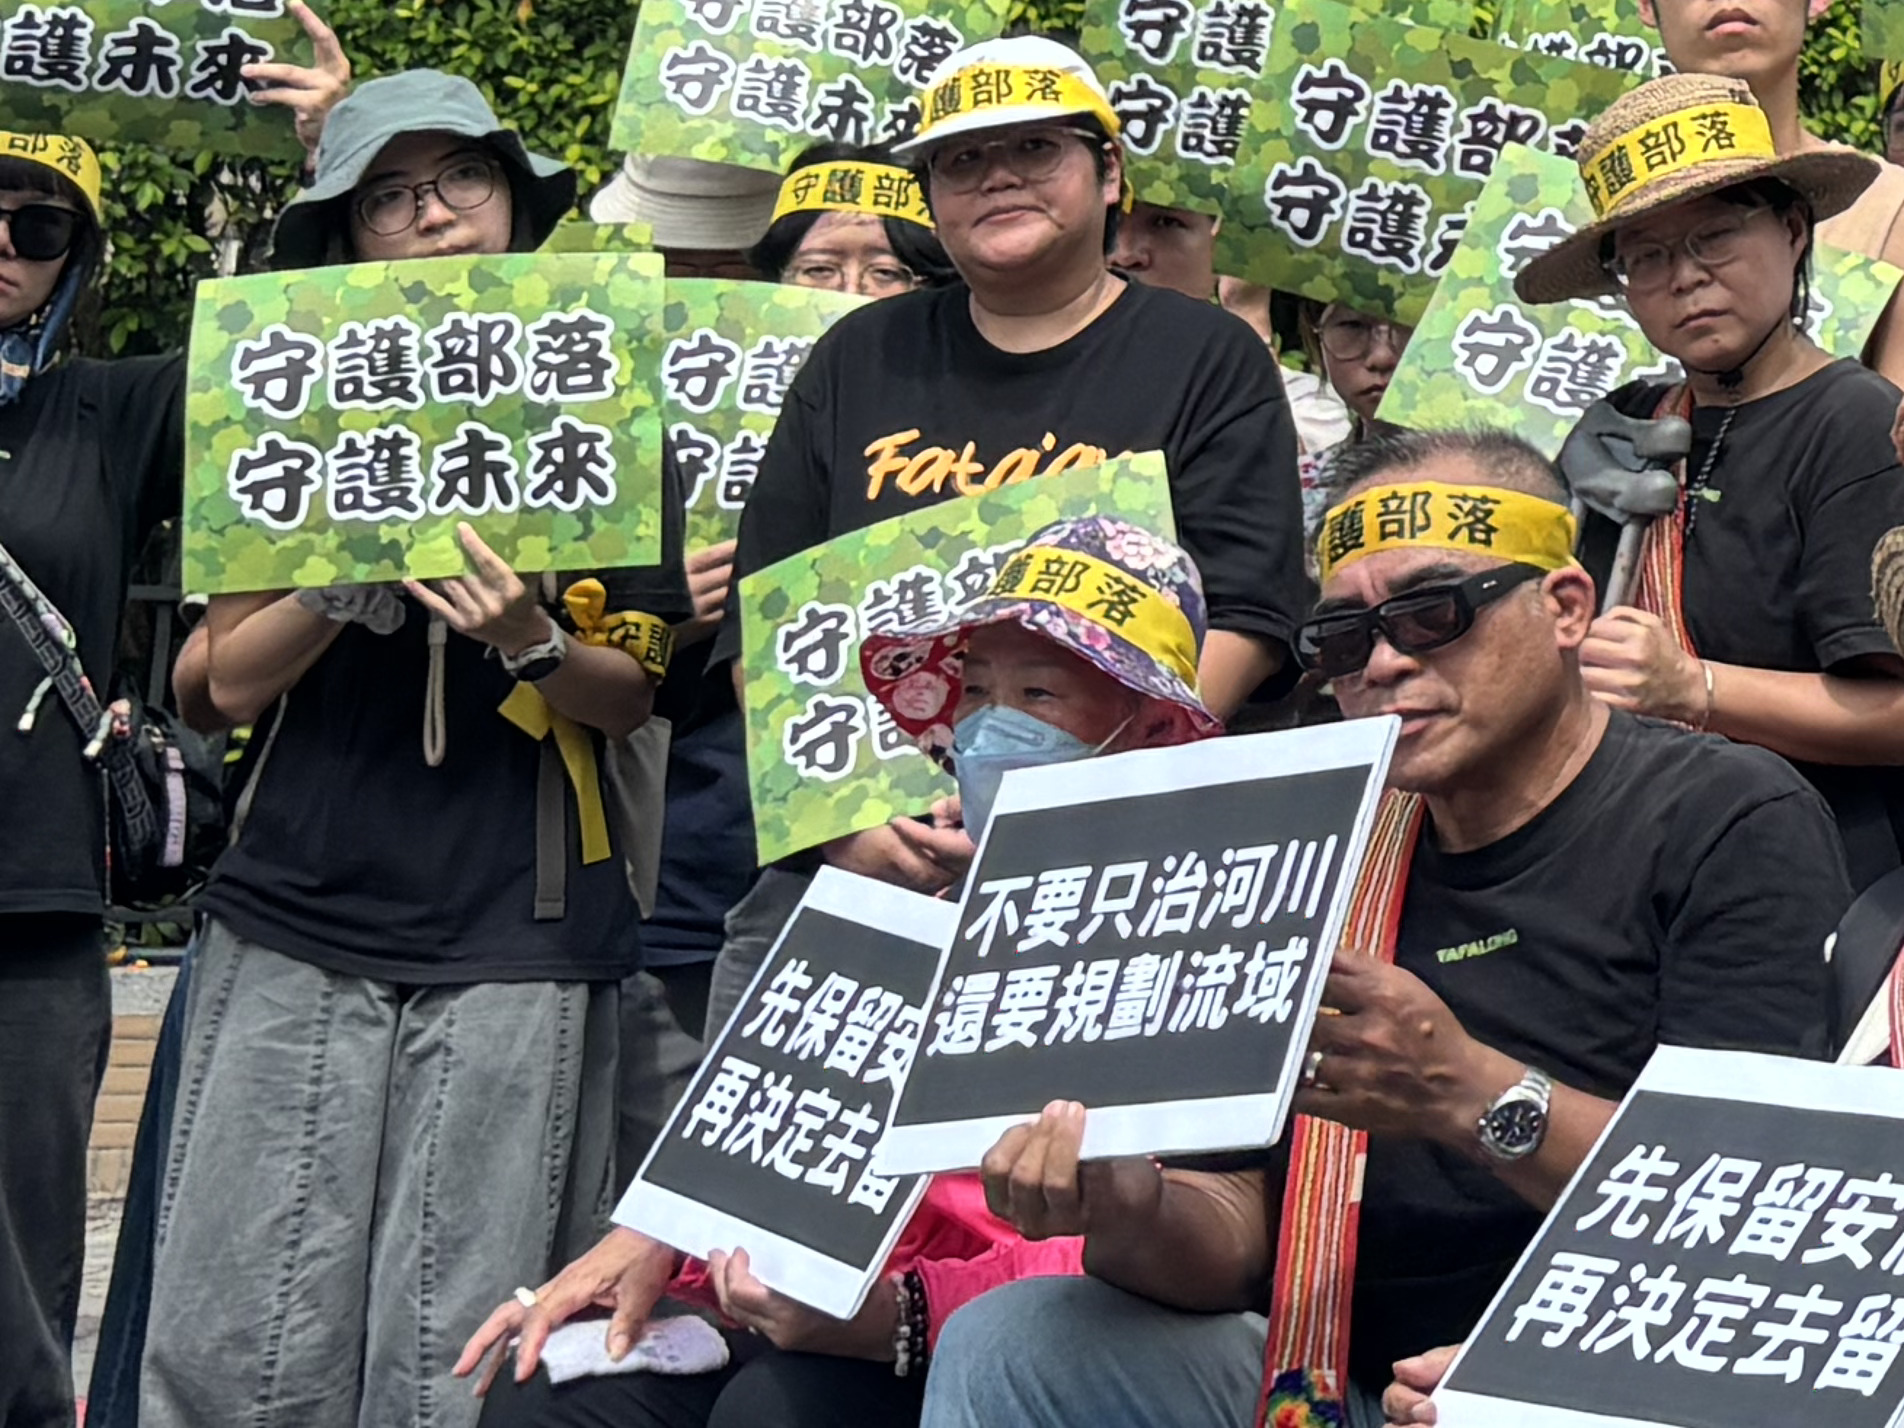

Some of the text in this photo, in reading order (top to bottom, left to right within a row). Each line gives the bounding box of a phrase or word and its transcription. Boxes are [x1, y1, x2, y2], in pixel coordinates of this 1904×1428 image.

[788, 167, 930, 216] 守護部
[239, 315, 613, 410] 守護部落
[1462, 310, 1684, 408] 守護
[236, 421, 611, 521] 守護未來
[967, 834, 1339, 957] 不要只治河川
[927, 937, 1308, 1058] 還要規劃流域
